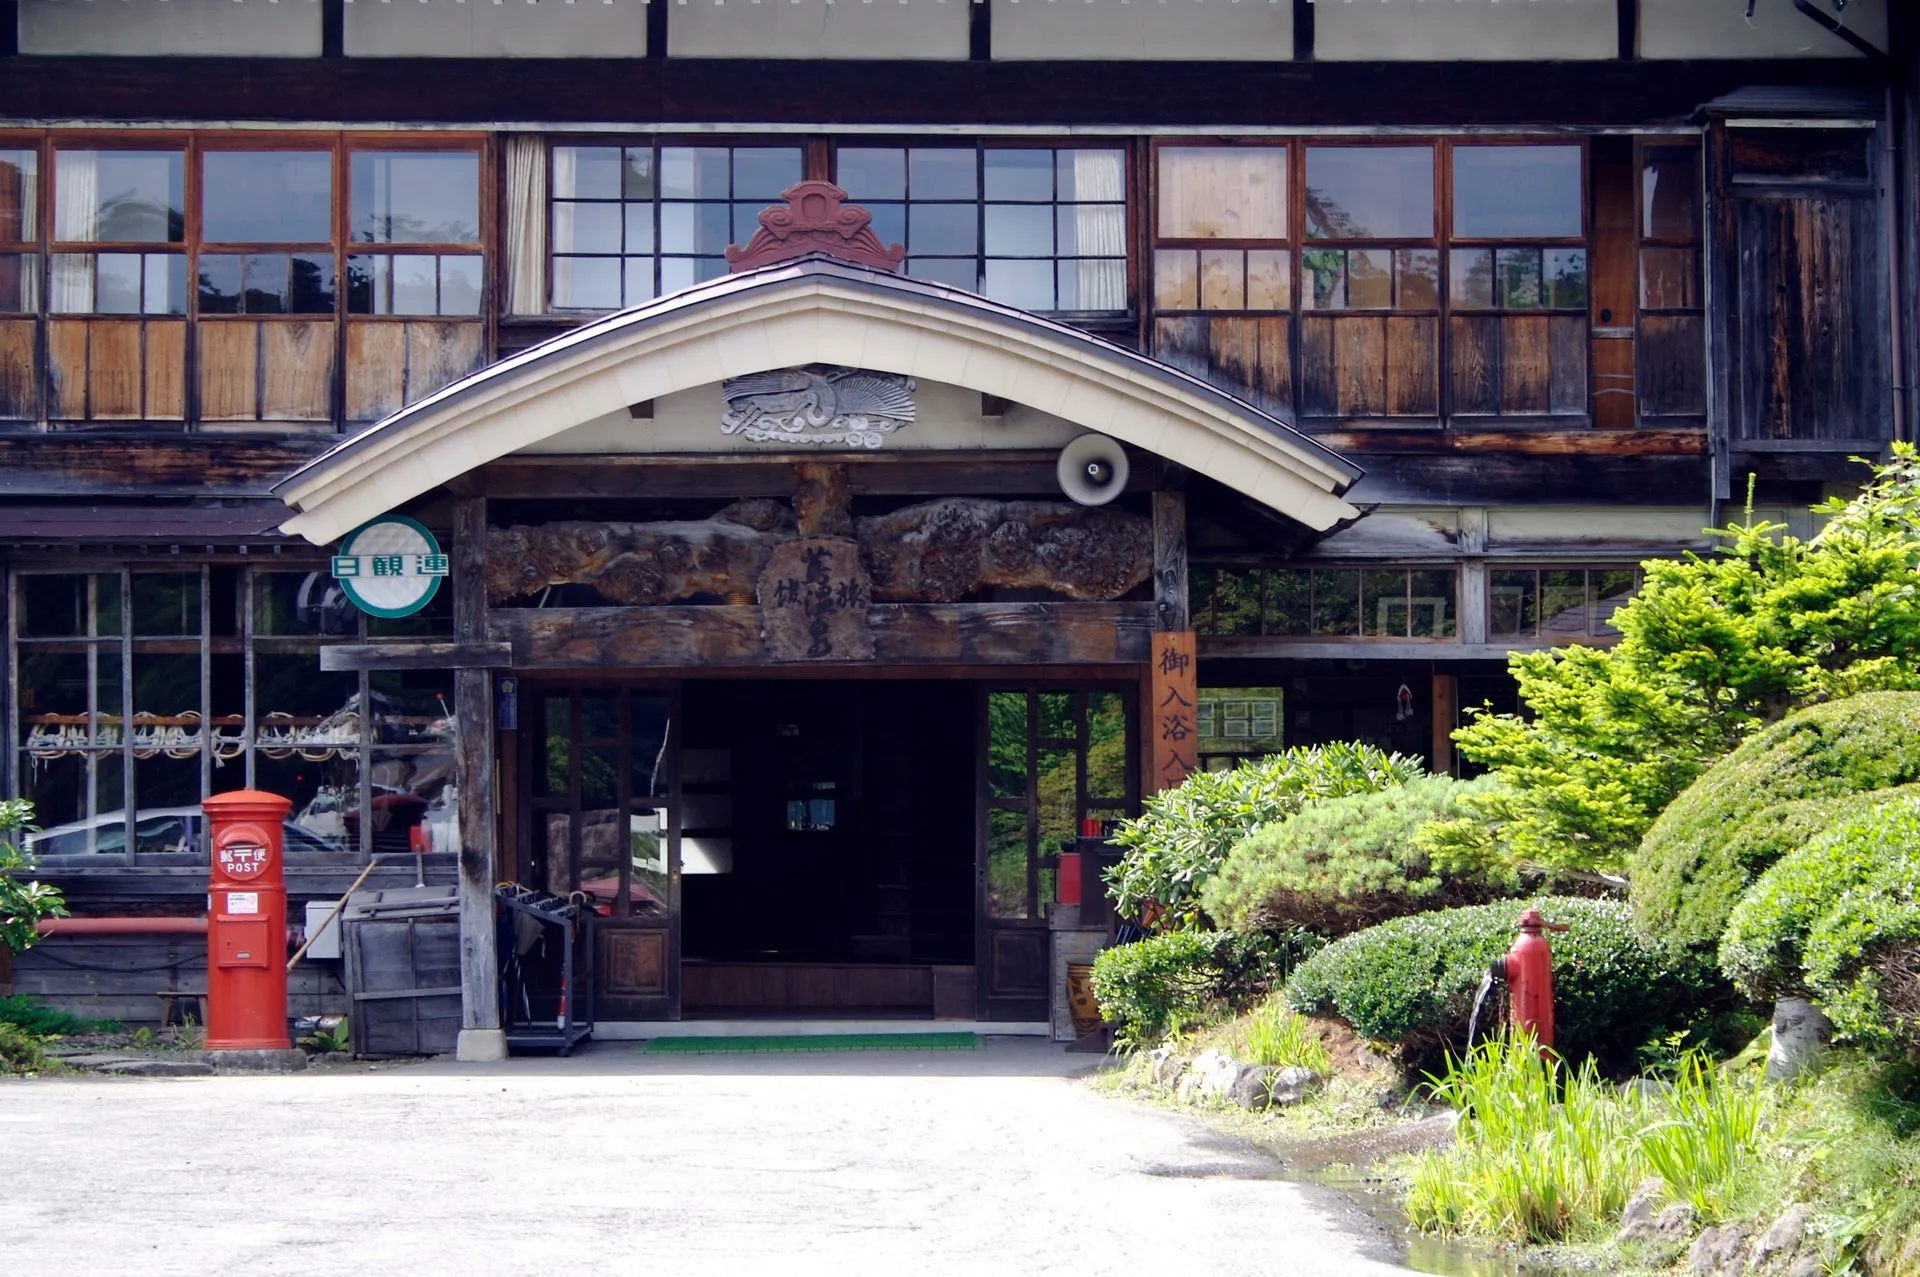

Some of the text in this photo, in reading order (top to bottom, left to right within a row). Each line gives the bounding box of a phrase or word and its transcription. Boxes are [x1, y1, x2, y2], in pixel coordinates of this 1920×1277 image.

[333, 554, 448, 577] 日観連
[227, 862, 259, 872] POST
